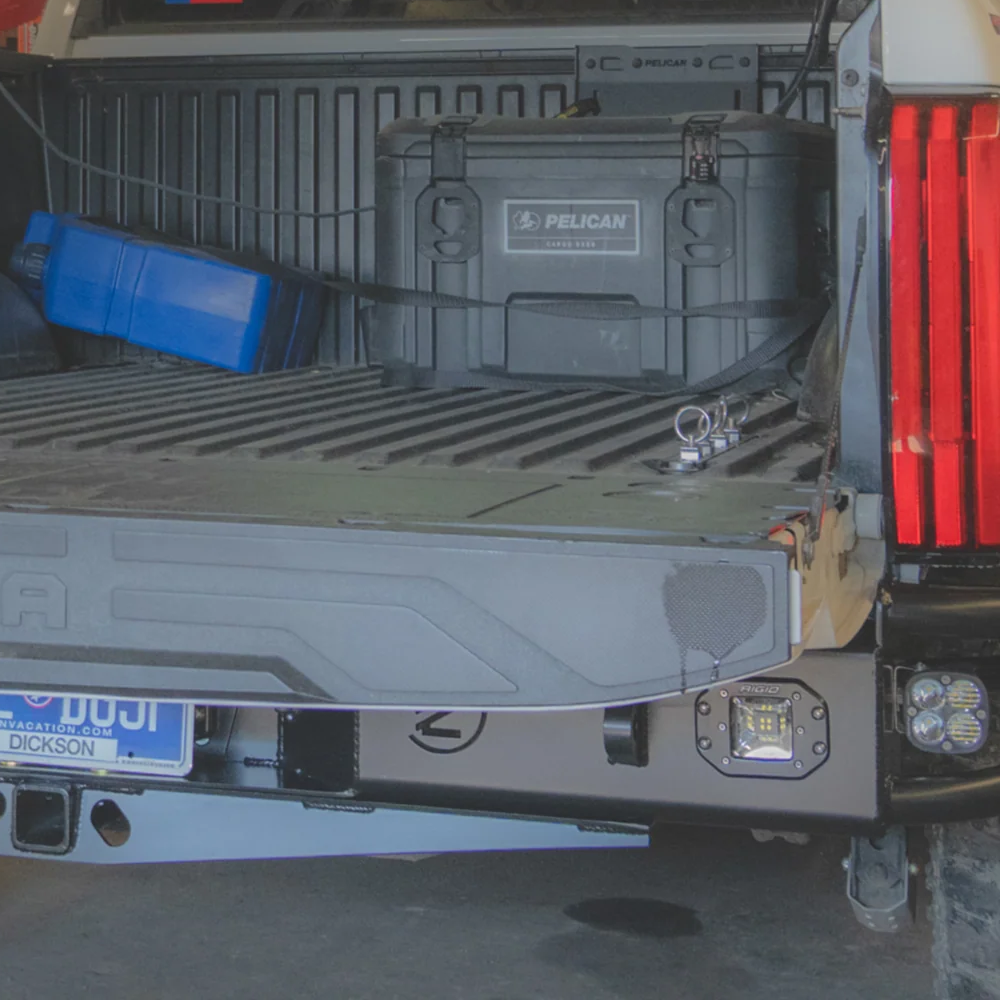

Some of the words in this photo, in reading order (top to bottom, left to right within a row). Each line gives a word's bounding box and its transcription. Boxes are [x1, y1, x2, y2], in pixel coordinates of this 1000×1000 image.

[645, 59, 688, 68] PELICAN
[545, 213, 627, 230] PELICAN
[740, 685, 780, 694] RIGID
[9, 733, 95, 757] DICKSON
